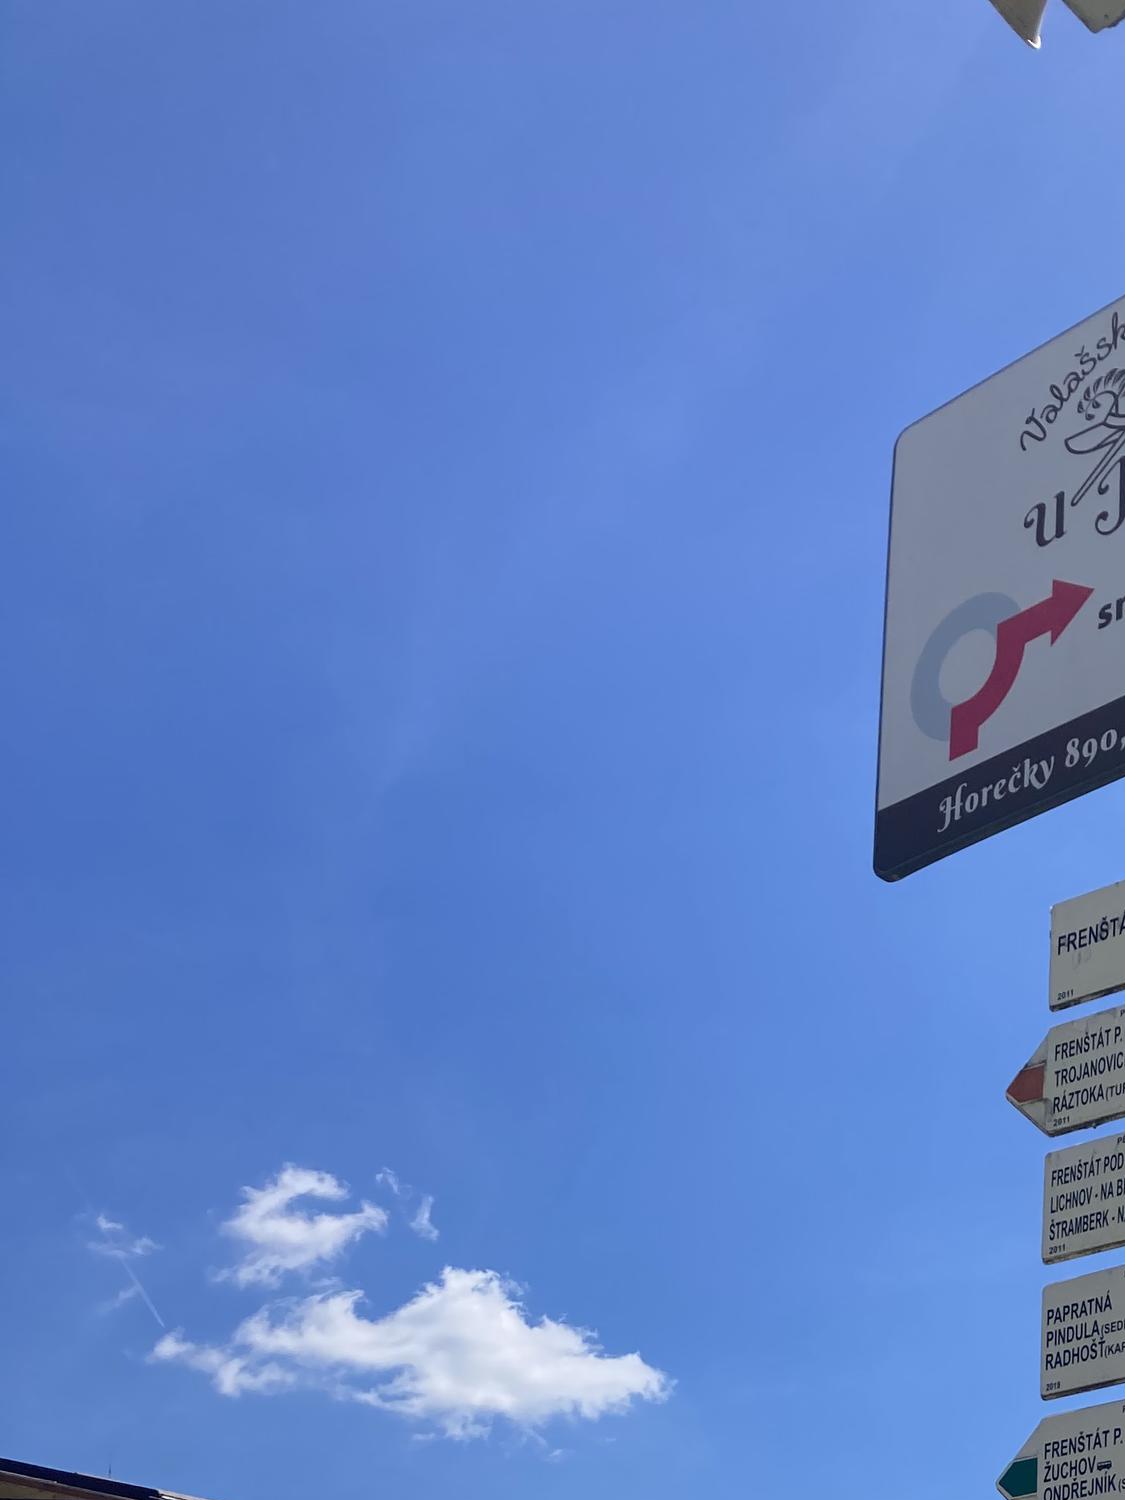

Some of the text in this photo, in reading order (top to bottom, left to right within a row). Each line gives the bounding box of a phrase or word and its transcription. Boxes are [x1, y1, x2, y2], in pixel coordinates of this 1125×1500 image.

[1023, 491, 1067, 547] U
[937, 755, 1056, 833] Horečky
[1054, 1024, 1112, 1062] FRENŠTÁT
[1052, 1081, 1105, 1115] RÁZTOKA
[1051, 1152, 1102, 1187] FRENŠTÁT
[1103, 1152, 1124, 1174] POD
[1050, 1188, 1093, 1214] LICHNOV
[1100, 1181, 1115, 1200] NA
[1049, 1210, 1109, 1241] ŠTRAMBERK
[1046, 1290, 1112, 1326] PAPRATNÁ
[1046, 1320, 1101, 1348] PINDULA
[1045, 1337, 1106, 1371] RADHOŠŤ
[1044, 1426, 1110, 1460] FRENŠTÁT
[1043, 1455, 1096, 1483] ŽUCHOV
